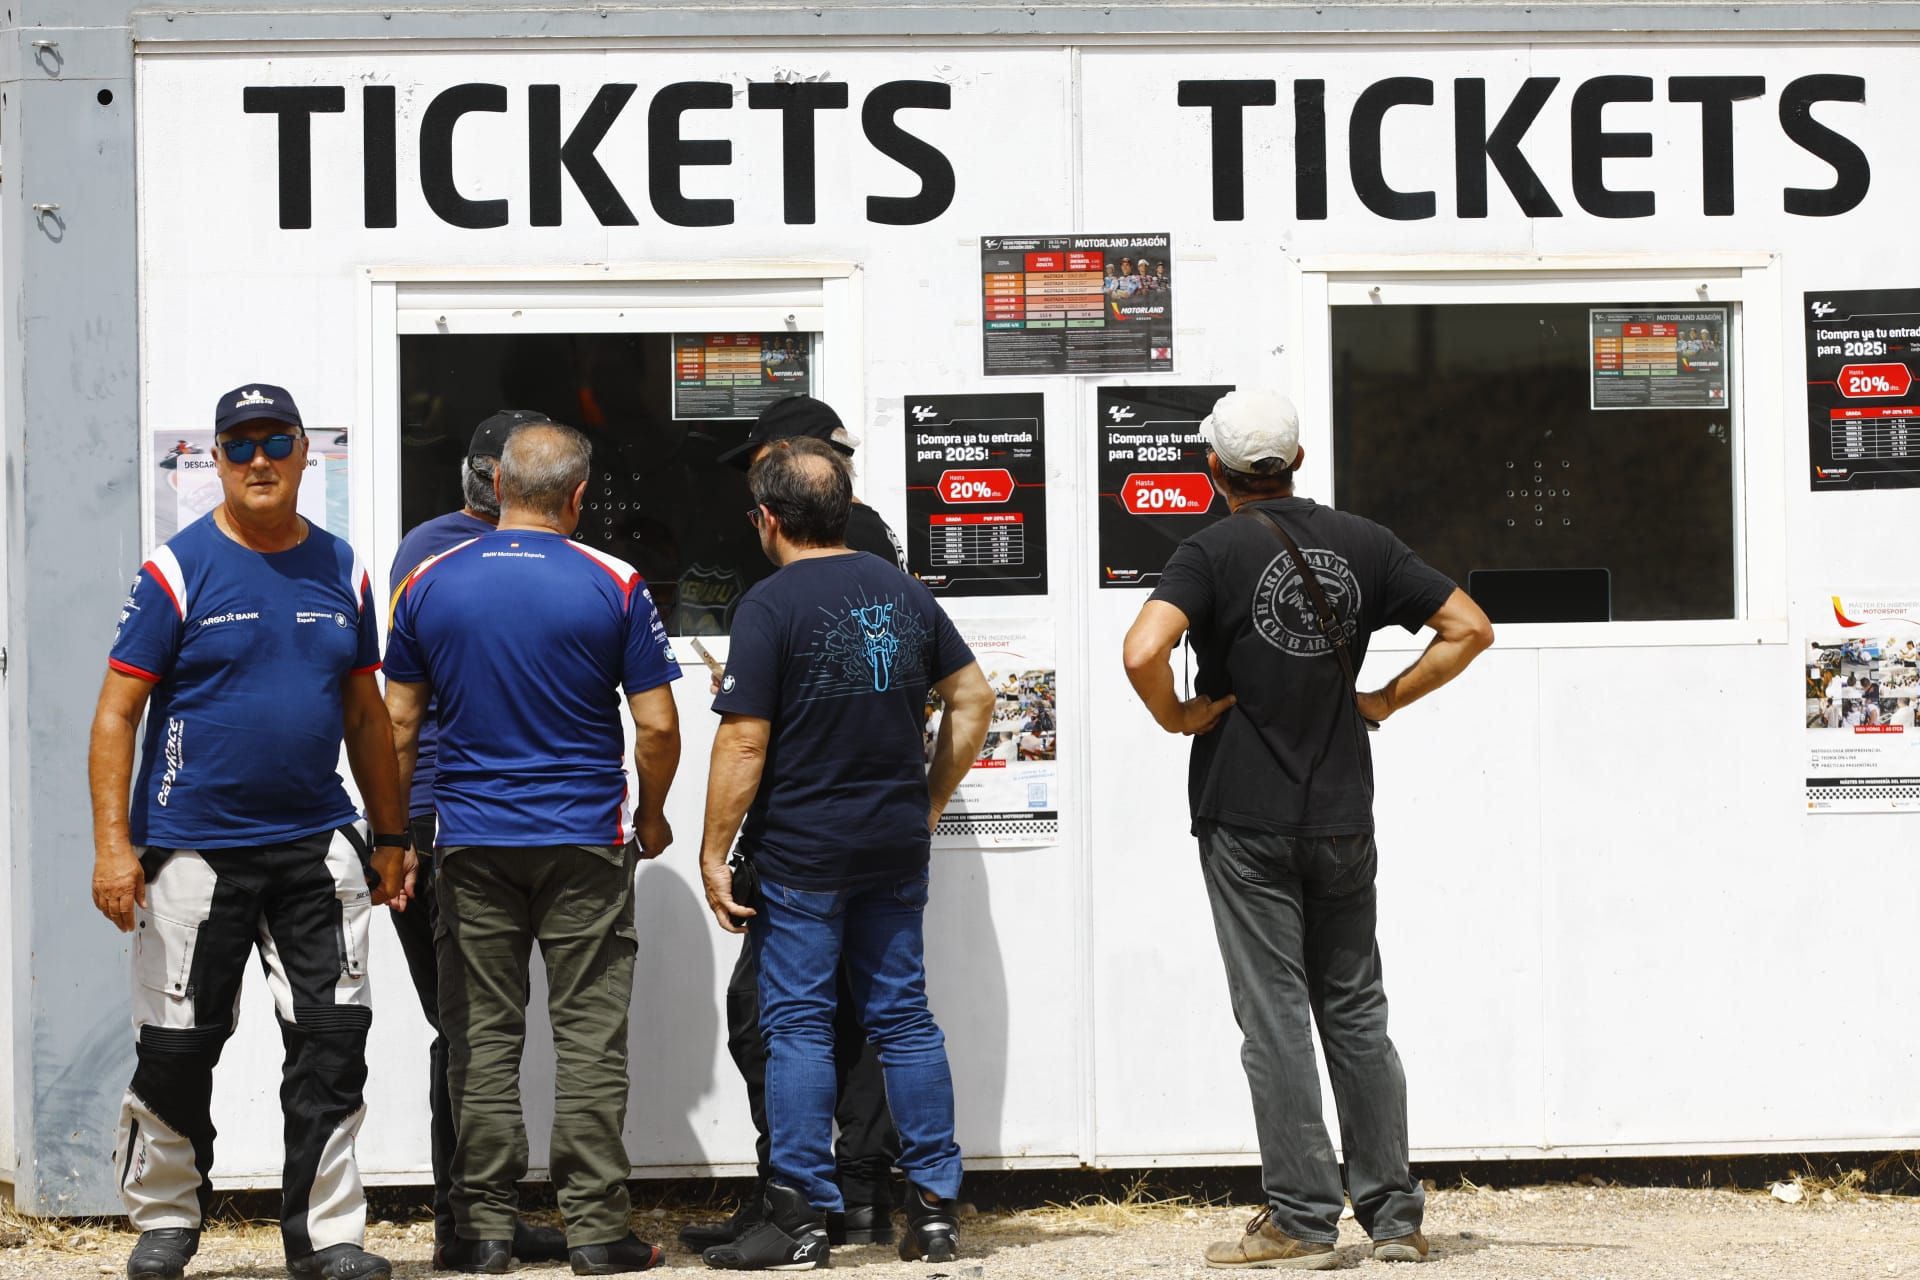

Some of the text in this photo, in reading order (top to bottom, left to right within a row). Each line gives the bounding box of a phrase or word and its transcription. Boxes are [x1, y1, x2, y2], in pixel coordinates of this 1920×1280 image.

[243, 78, 956, 229] TICKETS
[1178, 74, 1871, 221] TICKETS
[1075, 238, 1129, 248] MOTORLAND
[1130, 235, 1167, 247] ARAGÓN
[1121, 306, 1164, 314] MOTORLAND
[1817, 326, 1920, 342] ¡Compra ya tu entrad
[1818, 341, 1887, 357] para 2025!
[1850, 376, 1890, 393] 20%
[236, 399, 274, 409] MICHELIN
[917, 431, 1032, 446] ¡Compra ya tu entrada
[1109, 433, 1212, 446] ¡Compra ya tu entr
[918, 447, 989, 462] para 2025!
[1109, 447, 1181, 462] para 2025!
[184, 460, 217, 469] DESCAR
[950, 481, 991, 499] 20%
[1136, 488, 1187, 509] 20%
[1256, 554, 1295, 616] HARLE
[236, 612, 259, 621] BANK
[1262, 618, 1330, 651] CLUB AR
